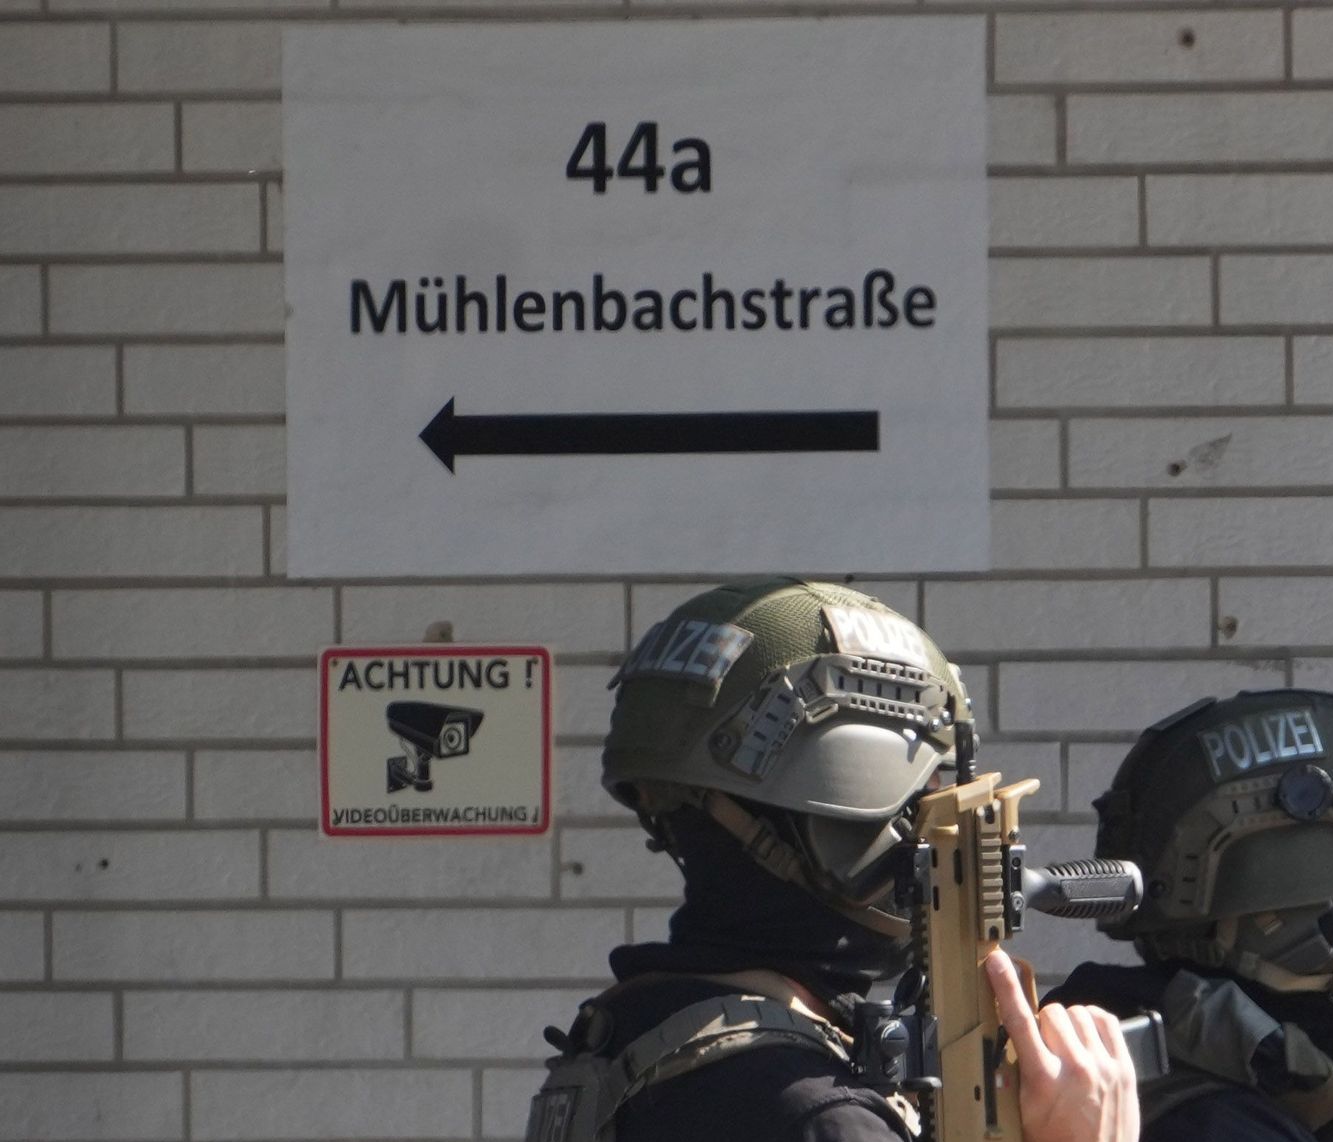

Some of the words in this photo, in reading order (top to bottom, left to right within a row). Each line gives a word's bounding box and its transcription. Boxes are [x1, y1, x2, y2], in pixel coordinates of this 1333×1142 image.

[565, 121, 713, 195] 44a
[350, 269, 937, 334] Mühlenbachstraße
[338, 659, 510, 691] ACHTUNG
[1203, 710, 1324, 777] POLIZEI
[333, 804, 528, 826] VIDEOÜBERWACHUNG
